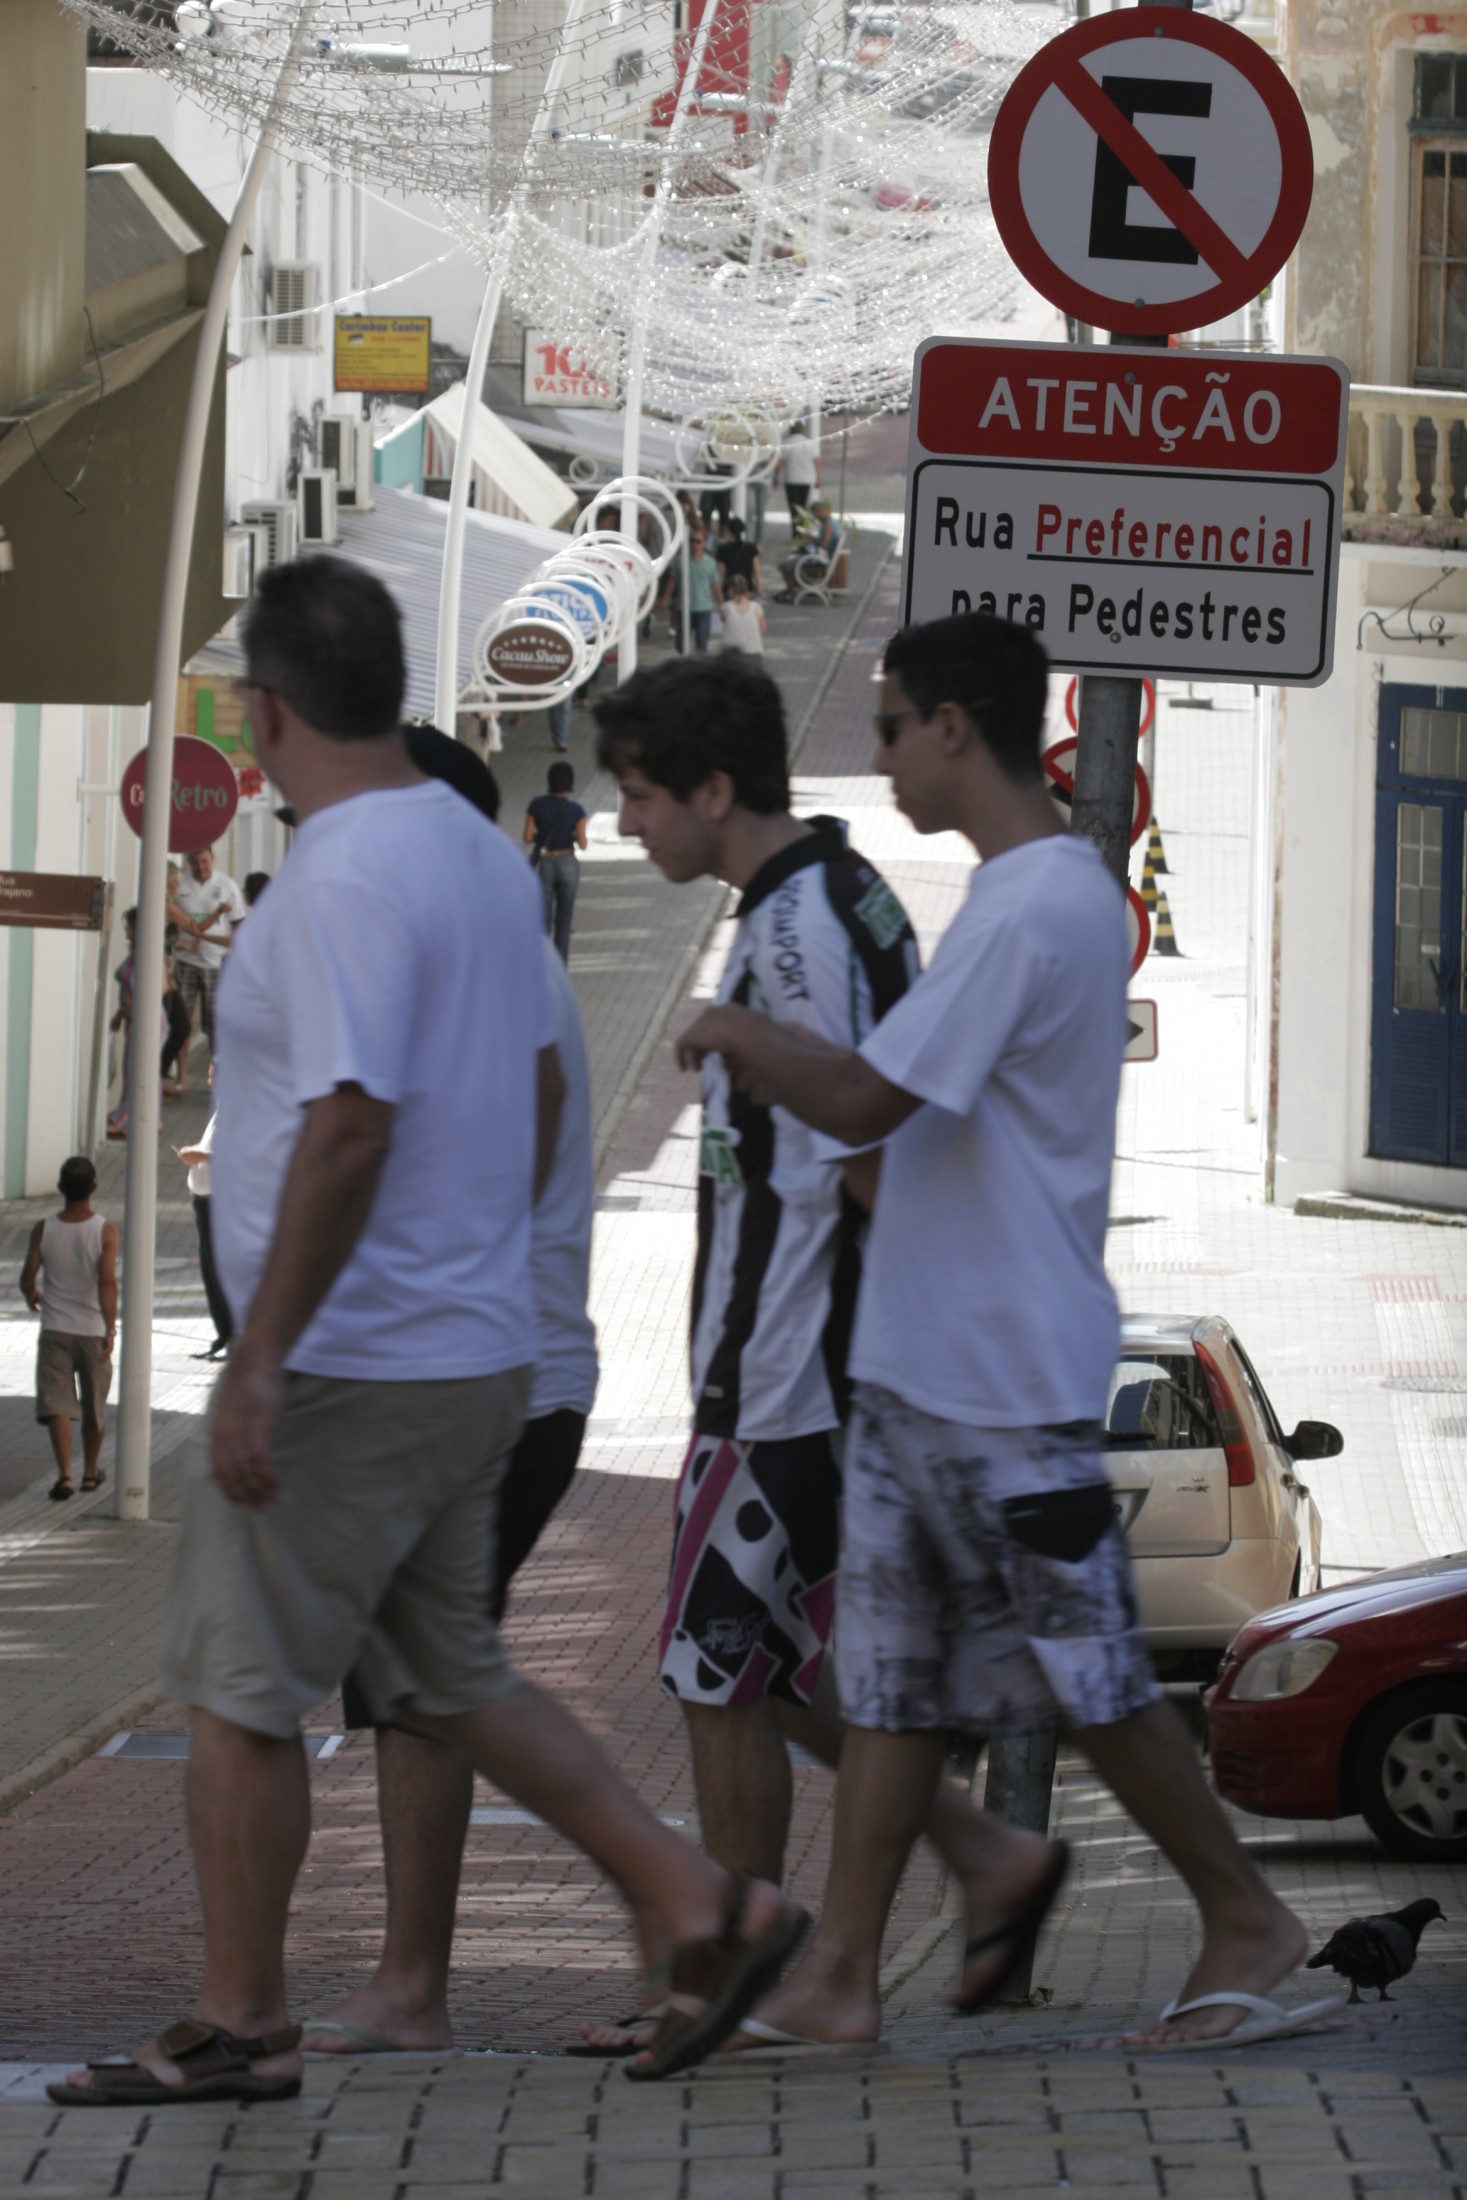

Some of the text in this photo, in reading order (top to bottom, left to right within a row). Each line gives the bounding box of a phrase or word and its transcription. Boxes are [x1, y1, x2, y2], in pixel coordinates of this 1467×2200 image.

[1088, 75, 1213, 265] E
[978, 371, 1282, 453] ATENÇÃO
[934, 496, 1312, 567] Rua Preferencial
[1068, 583, 1287, 645] Pedestres
[0, 886, 33, 898] rajano
